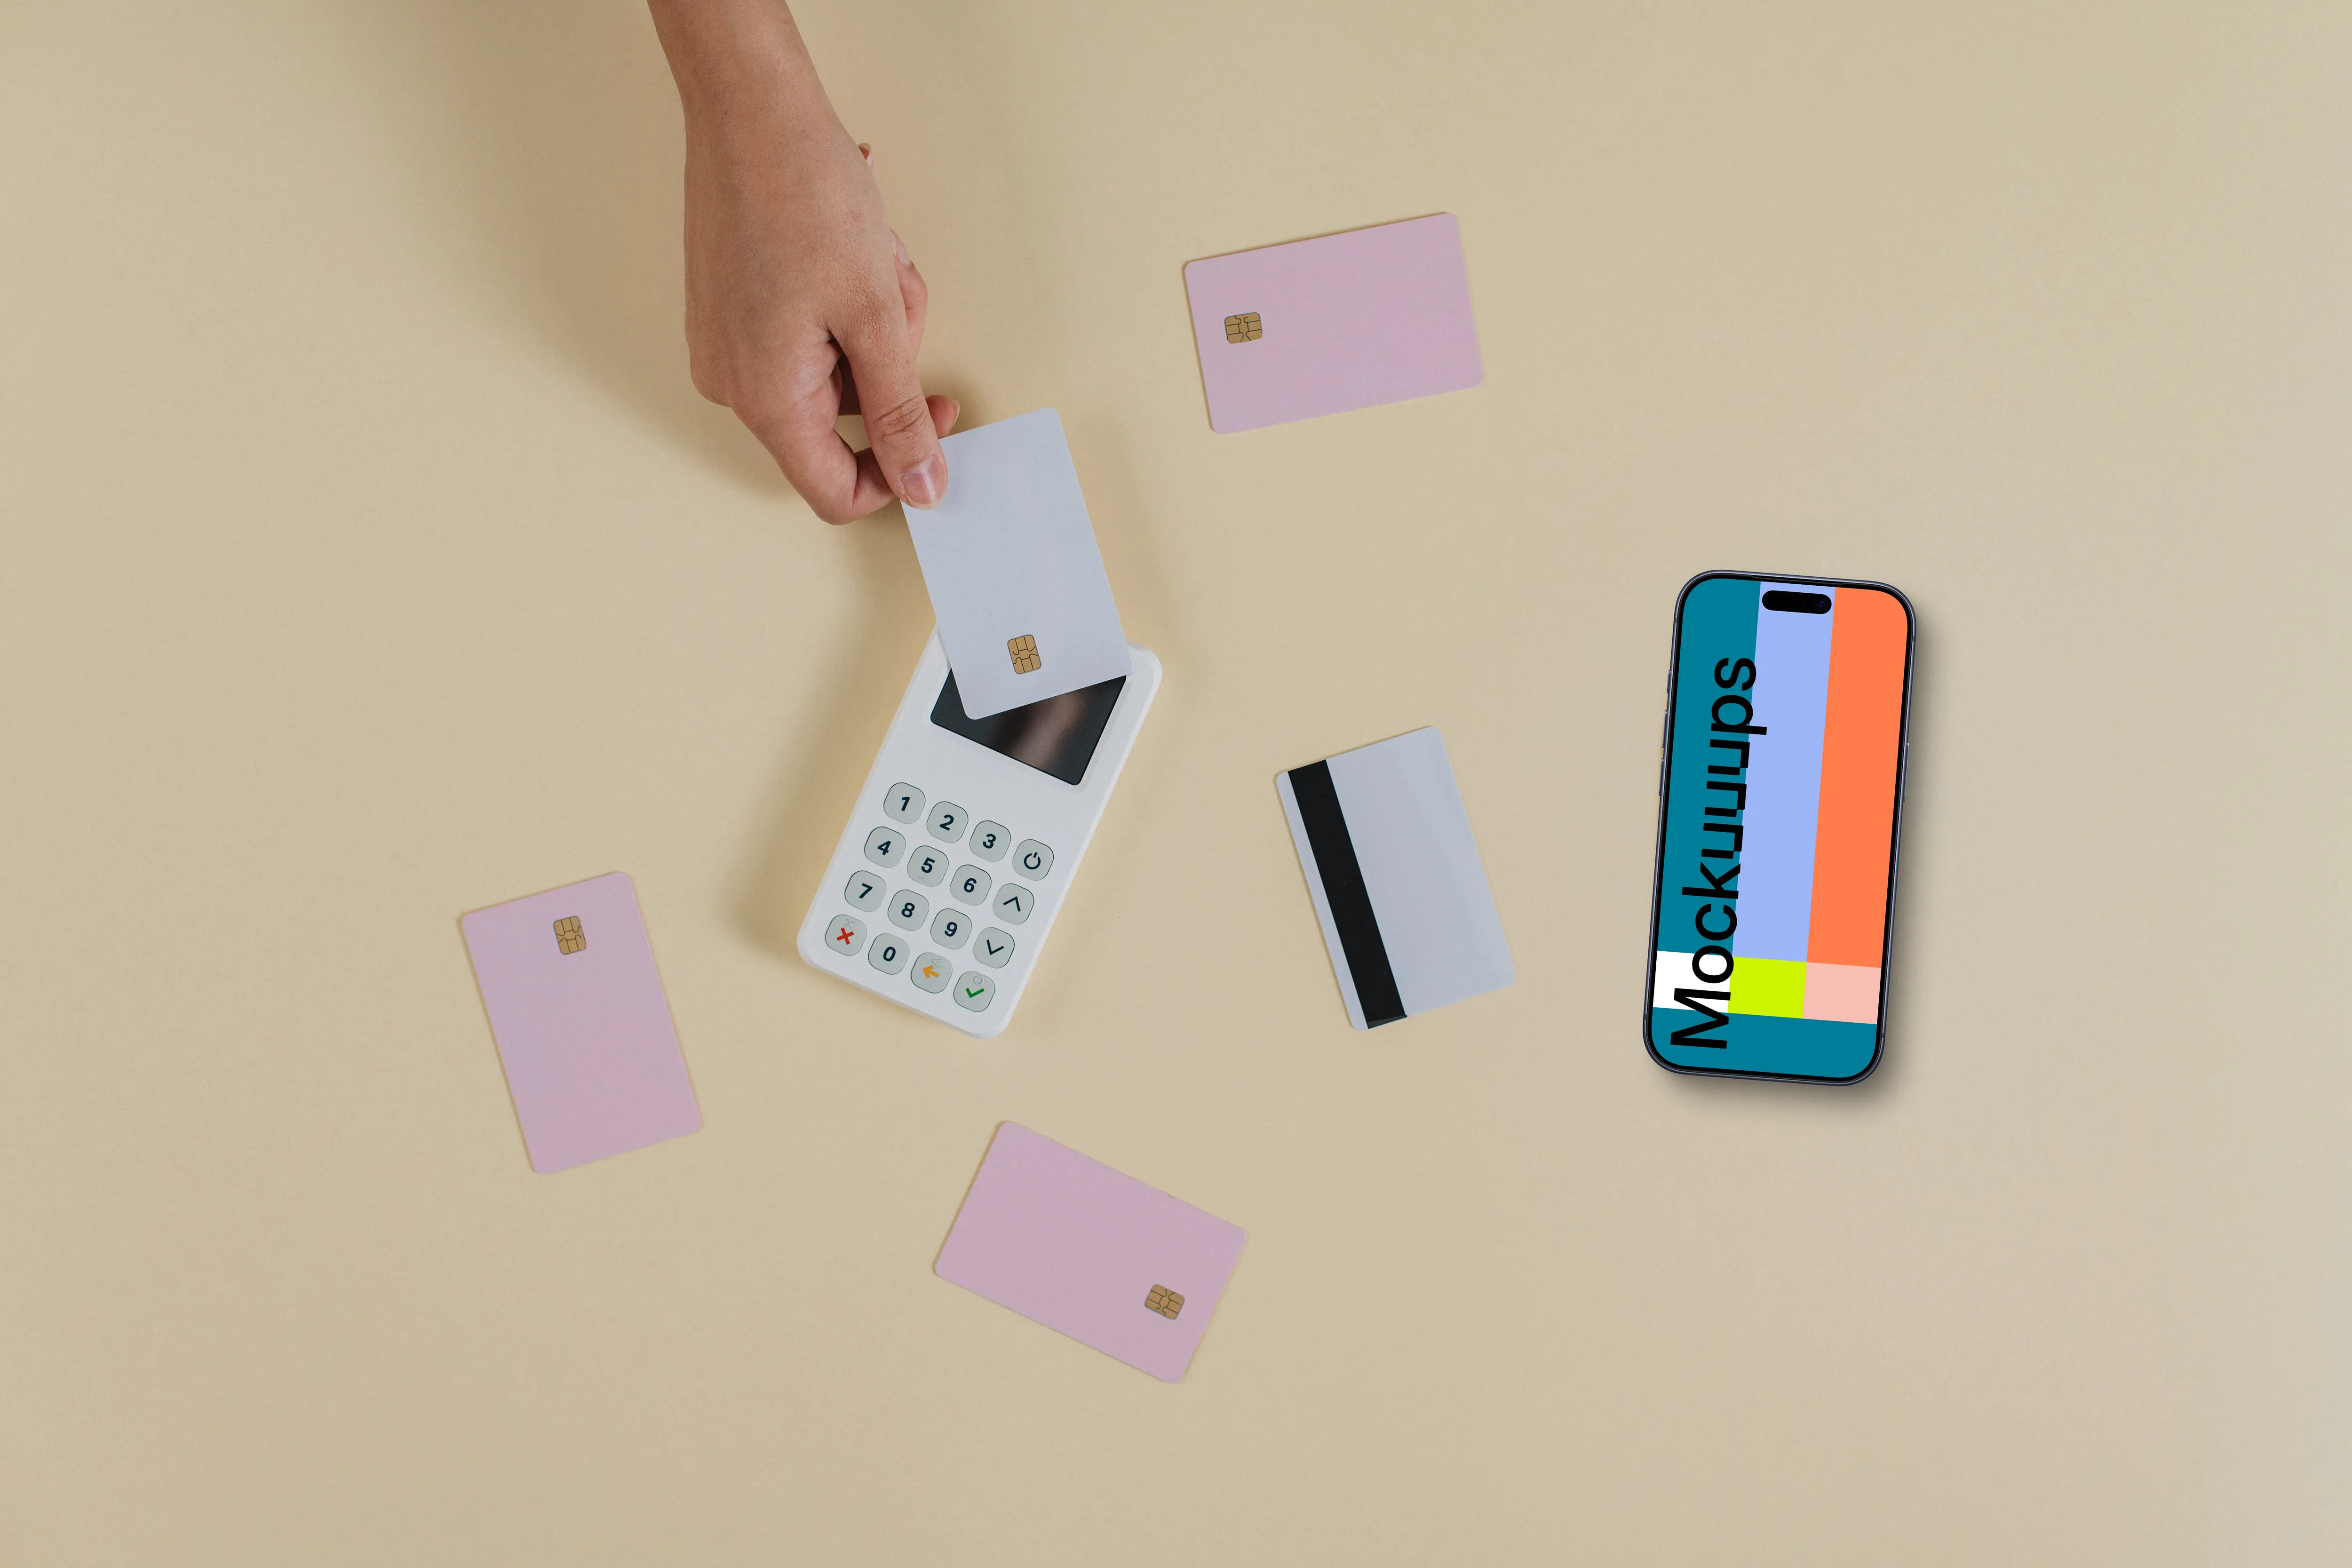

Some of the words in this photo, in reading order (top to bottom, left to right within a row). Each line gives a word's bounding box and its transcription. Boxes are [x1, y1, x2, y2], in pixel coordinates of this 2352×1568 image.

[901, 797, 910, 811] 1
[939, 814, 954, 831] 2
[983, 834, 996, 849] 3
[877, 841, 891, 855] 4
[922, 857, 935, 873] 5
[964, 878, 977, 892] 6
[1670, 657, 1767, 1049] Mockuuups
[859, 883, 873, 899] 7
[901, 903, 915, 917] 8
[945, 922, 957, 937] 9
[883, 947, 896, 961] 0
